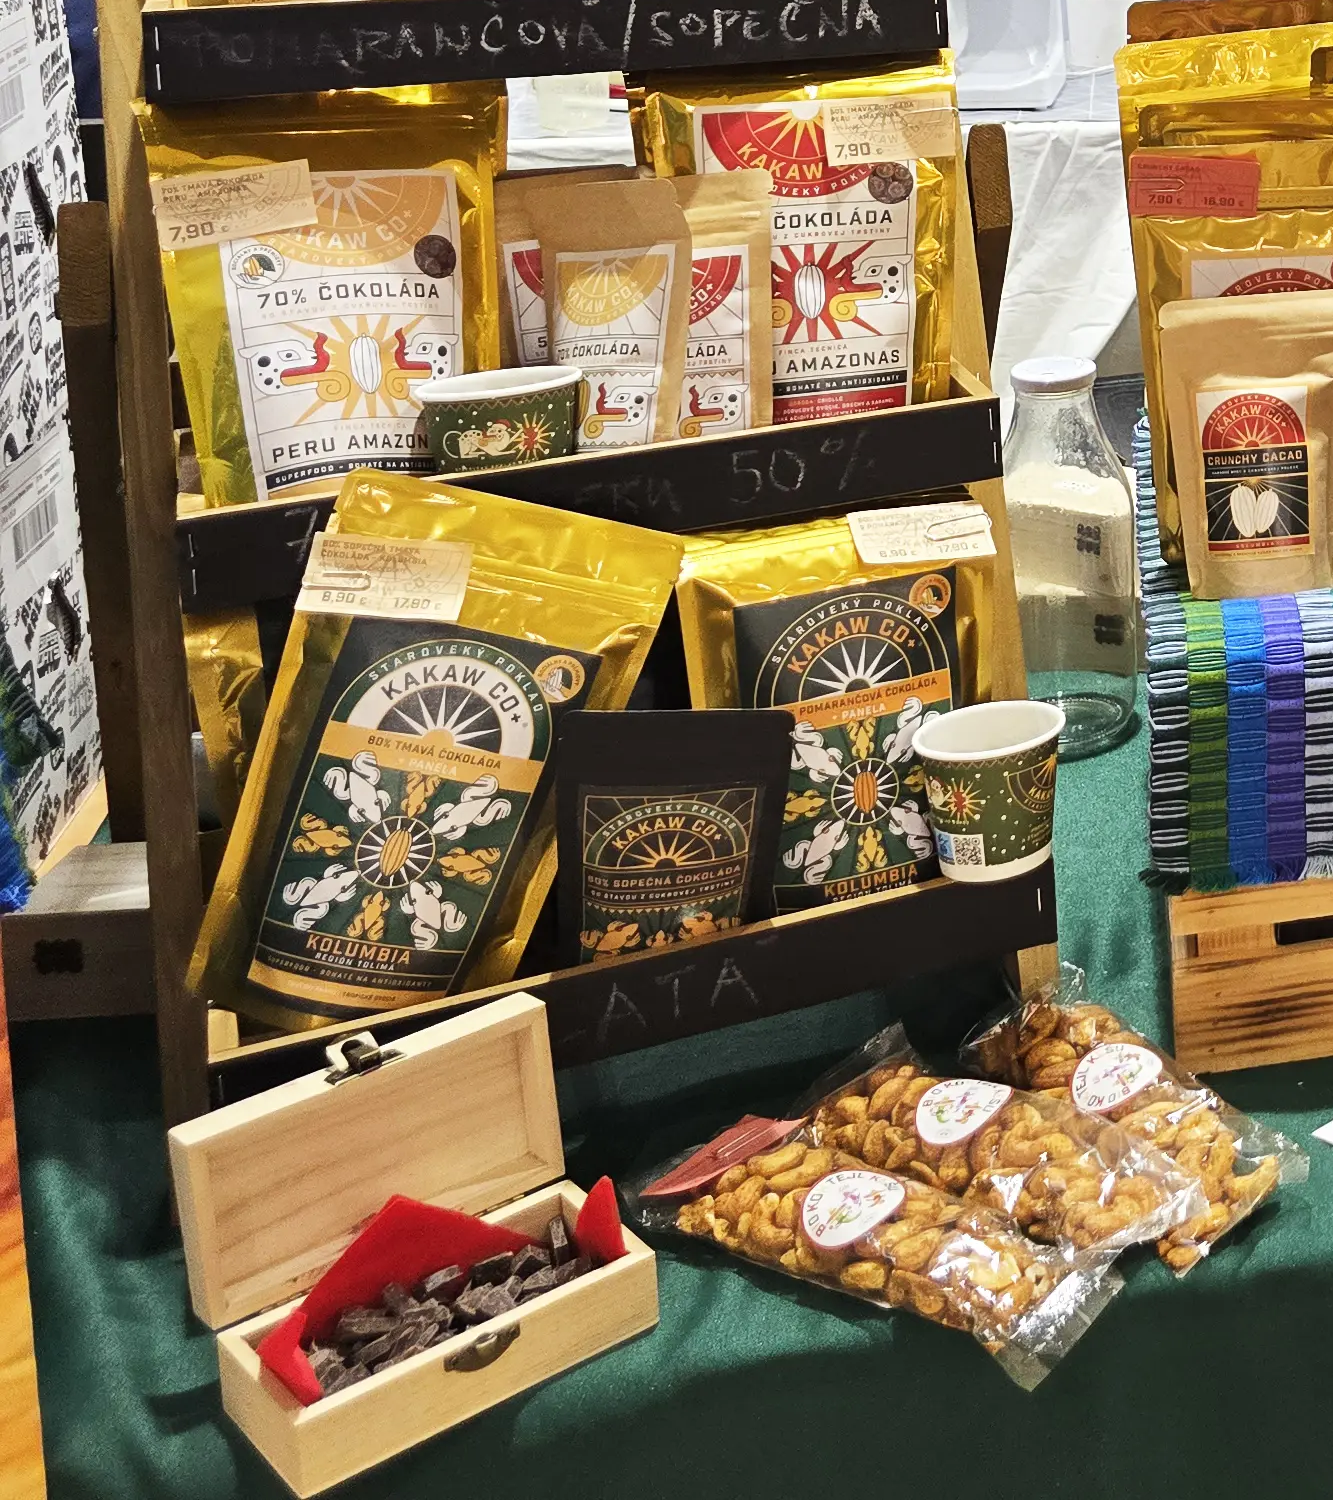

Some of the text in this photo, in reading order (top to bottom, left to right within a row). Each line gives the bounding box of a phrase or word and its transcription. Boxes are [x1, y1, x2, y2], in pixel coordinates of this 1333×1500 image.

[737, 142, 824, 181] KAKAW
[835, 142, 871, 160] 7,90
[168, 220, 214, 243] 7,90
[774, 207, 893, 230] ČOKOLÁDA
[257, 281, 441, 310] 70% ČOKOLÁDA
[566, 285, 606, 314] KAKAW
[572, 342, 641, 358] ČOKOLÁDA
[786, 349, 901, 375] AMAZONAS
[825, 380, 837, 388] NA
[1215, 403, 1261, 434] KAKAW
[272, 435, 336, 464] PERU
[1206, 449, 1304, 466] CRUNCHY CACAO
[275, 465, 335, 484] SUPERFOOD
[321, 591, 355, 604] 8,90
[771, 597, 930, 664] STAROVEKÝ POKLAD
[787, 614, 870, 675] KAKAW
[368, 645, 545, 713] STAROVEKÝ POKLAD
[381, 664, 487, 701] KAKAW
[799, 677, 938, 717] POMARANČOVÁ ČOKOLÁDA
[841, 703, 887, 721] PANELA
[368, 735, 501, 770] 80% TMAVÁ ČOKOLÁDA
[408, 758, 458, 778] PANELA
[602, 802, 684, 839] STAROVEKÝ
[611, 816, 686, 851] KAKAW
[613, 875, 672, 889] SOPEČNÁ
[676, 864, 742, 885] ČOKOLÁDA
[824, 863, 919, 898] KOLUMBIA
[306, 933, 412, 965] KOLUMBIA
[314, 951, 395, 972] REGIÓN TOLIMA
